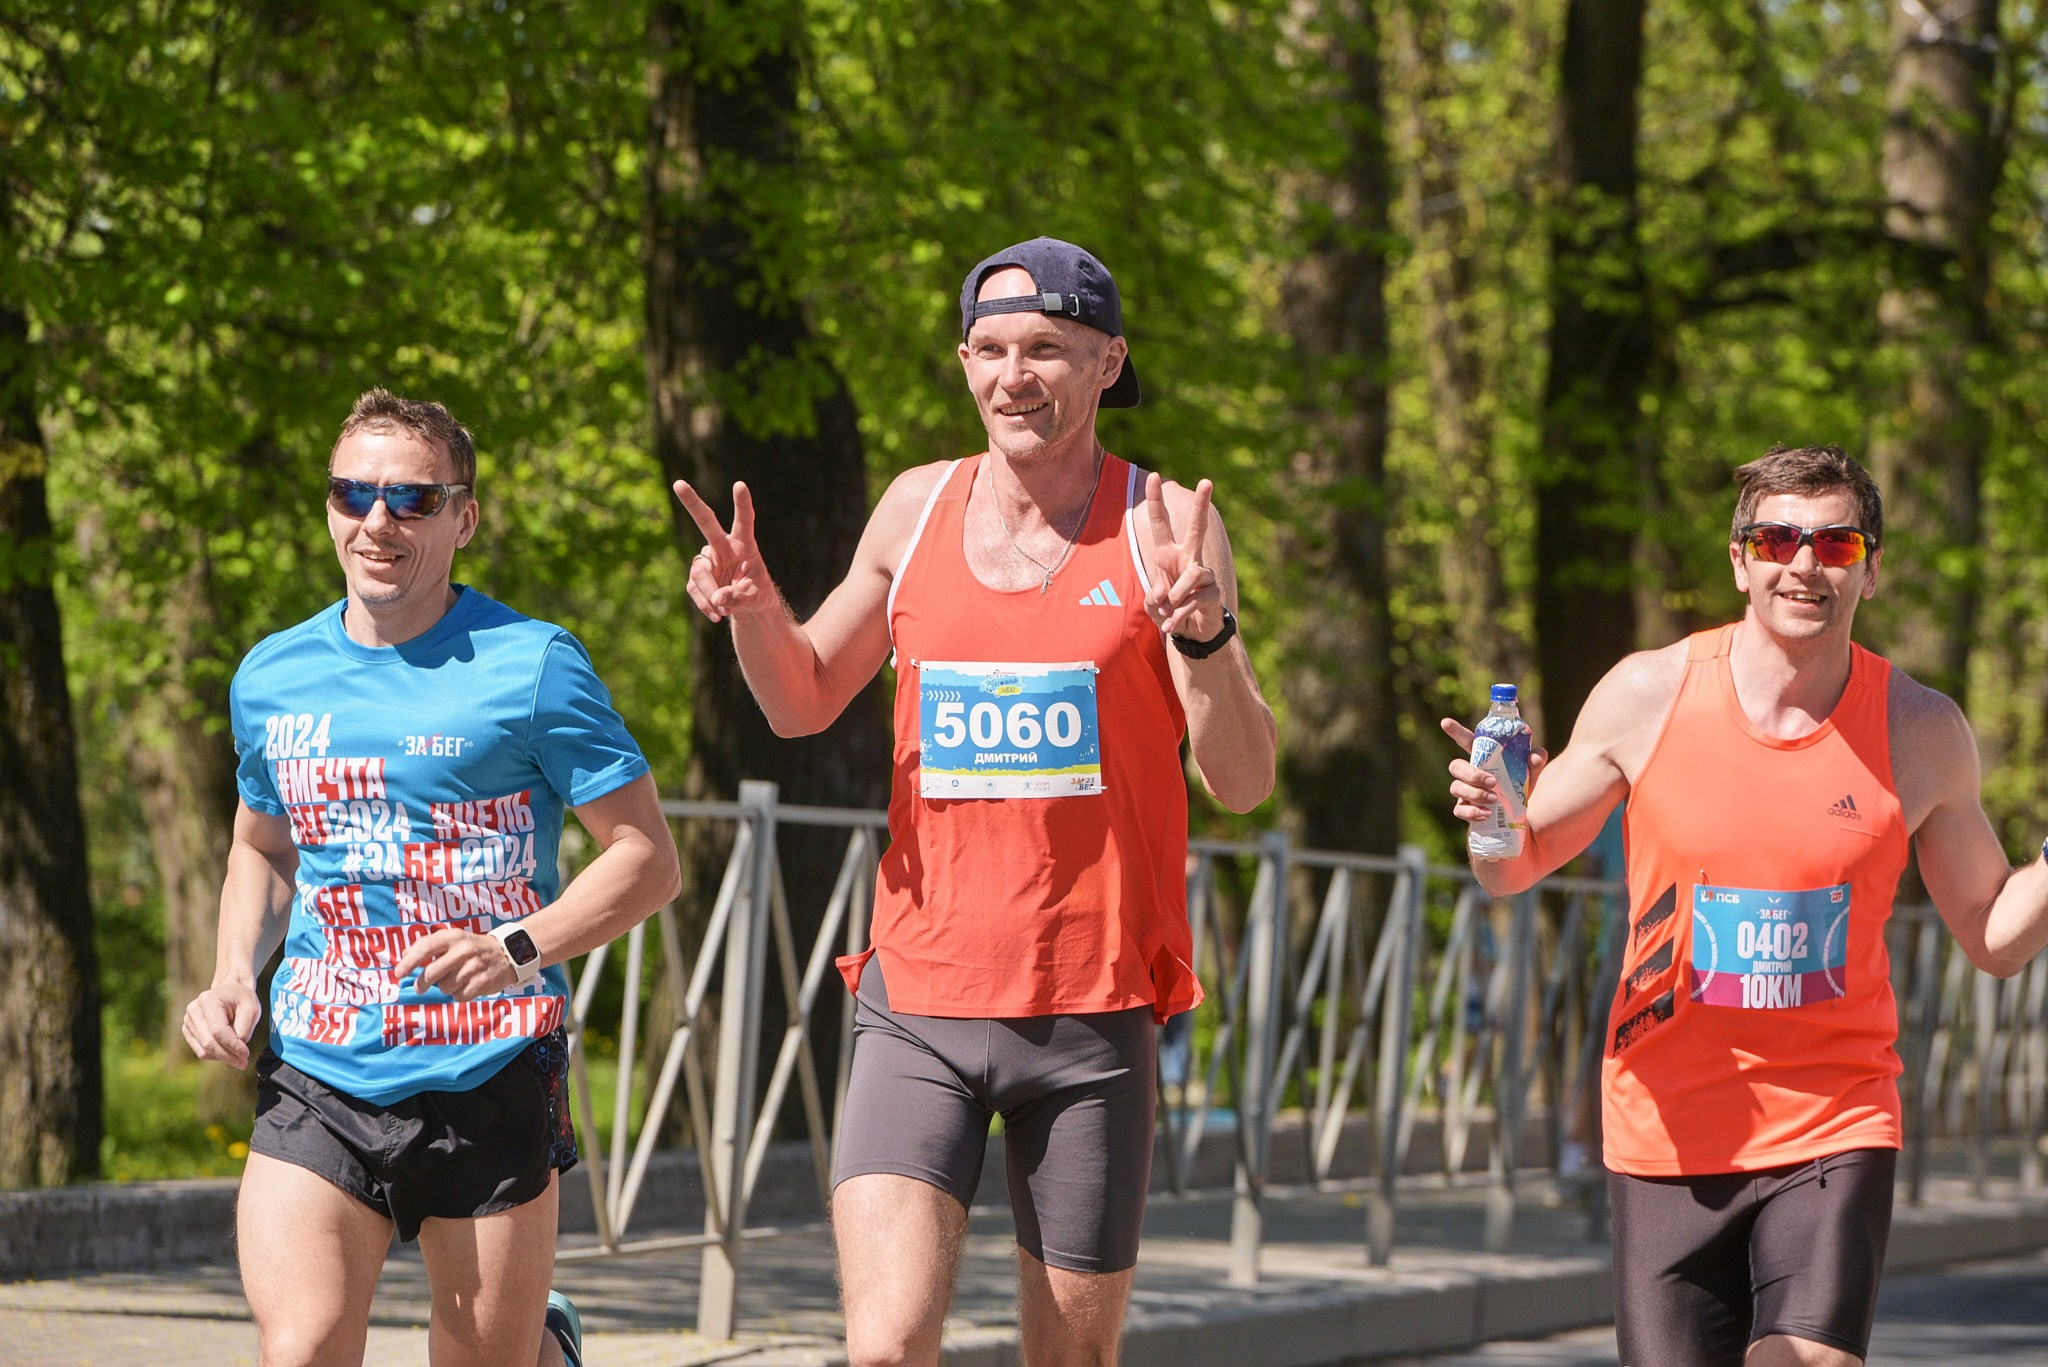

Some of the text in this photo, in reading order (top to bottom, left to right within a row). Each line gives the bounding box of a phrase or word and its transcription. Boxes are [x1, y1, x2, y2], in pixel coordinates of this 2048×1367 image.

[266, 713, 332, 759] 2024
[934, 702, 1082, 748] 5060
[1477, 739, 1498, 753] FRESH
[975, 752, 1038, 764] ДМИТРИЙ
[277, 757, 386, 804] #МЕЧТА
[289, 800, 412, 846] БЕГ2024
[431, 789, 535, 840] #ЦЕЛЬ
[1827, 807, 1862, 821] adidas
[342, 834, 537, 884] #ЗАБЕГ2024
[394, 876, 541, 923] #МОМЕНТ
[1716, 893, 1740, 904] ПСБ
[1736, 921, 1808, 960] 0402
[1752, 960, 1793, 974] ДМИТРИЙ
[1739, 973, 1802, 1010] 10КМ
